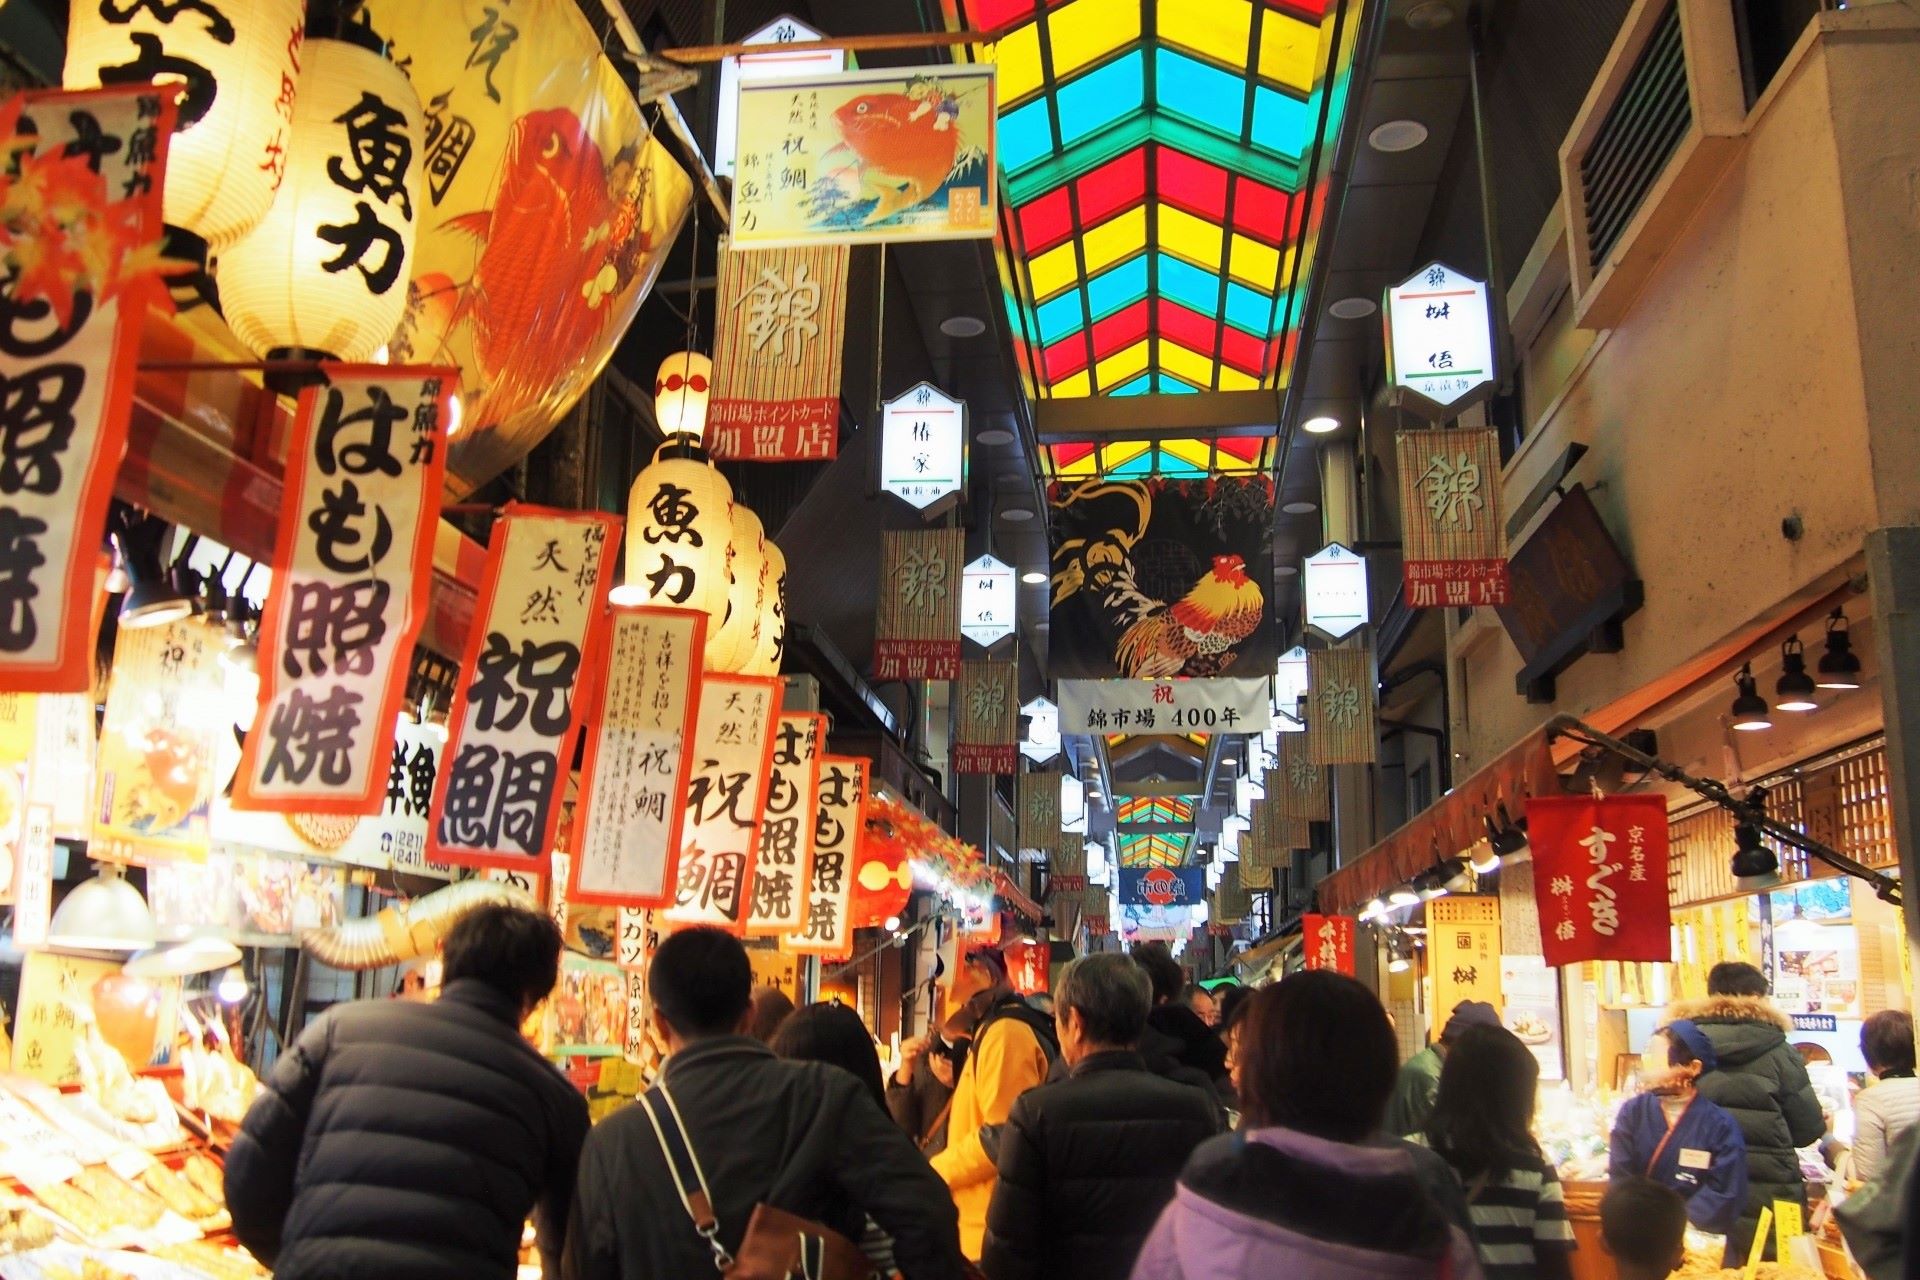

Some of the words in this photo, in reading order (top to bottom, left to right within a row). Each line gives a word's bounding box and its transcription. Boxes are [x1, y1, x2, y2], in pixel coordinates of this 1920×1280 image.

[315, 91, 413, 295] 魚力
[733, 264, 824, 368] 錦
[711, 423, 832, 459] 加盟店
[1414, 451, 1483, 533] 錦
[519, 539, 570, 626] 天然
[642, 483, 705, 604] 魚力
[891, 546, 947, 617] 錦
[260, 384, 408, 788] はも照焼
[1411, 579, 1505, 606] 加盟店
[878, 657, 957, 680] 加盟店
[1152, 683, 1175, 704] 祝
[438, 631, 582, 856] 祝鯛
[715, 691, 745, 745] 天然
[1087, 706, 1156, 728] 錦市場
[1171, 706, 1241, 728] 400年
[630, 742, 672, 824] 祝鯛
[673, 759, 758, 922] 祝鯛
[1579, 826, 1623, 936] すぐき
[1628, 825, 1647, 881] 京名産
